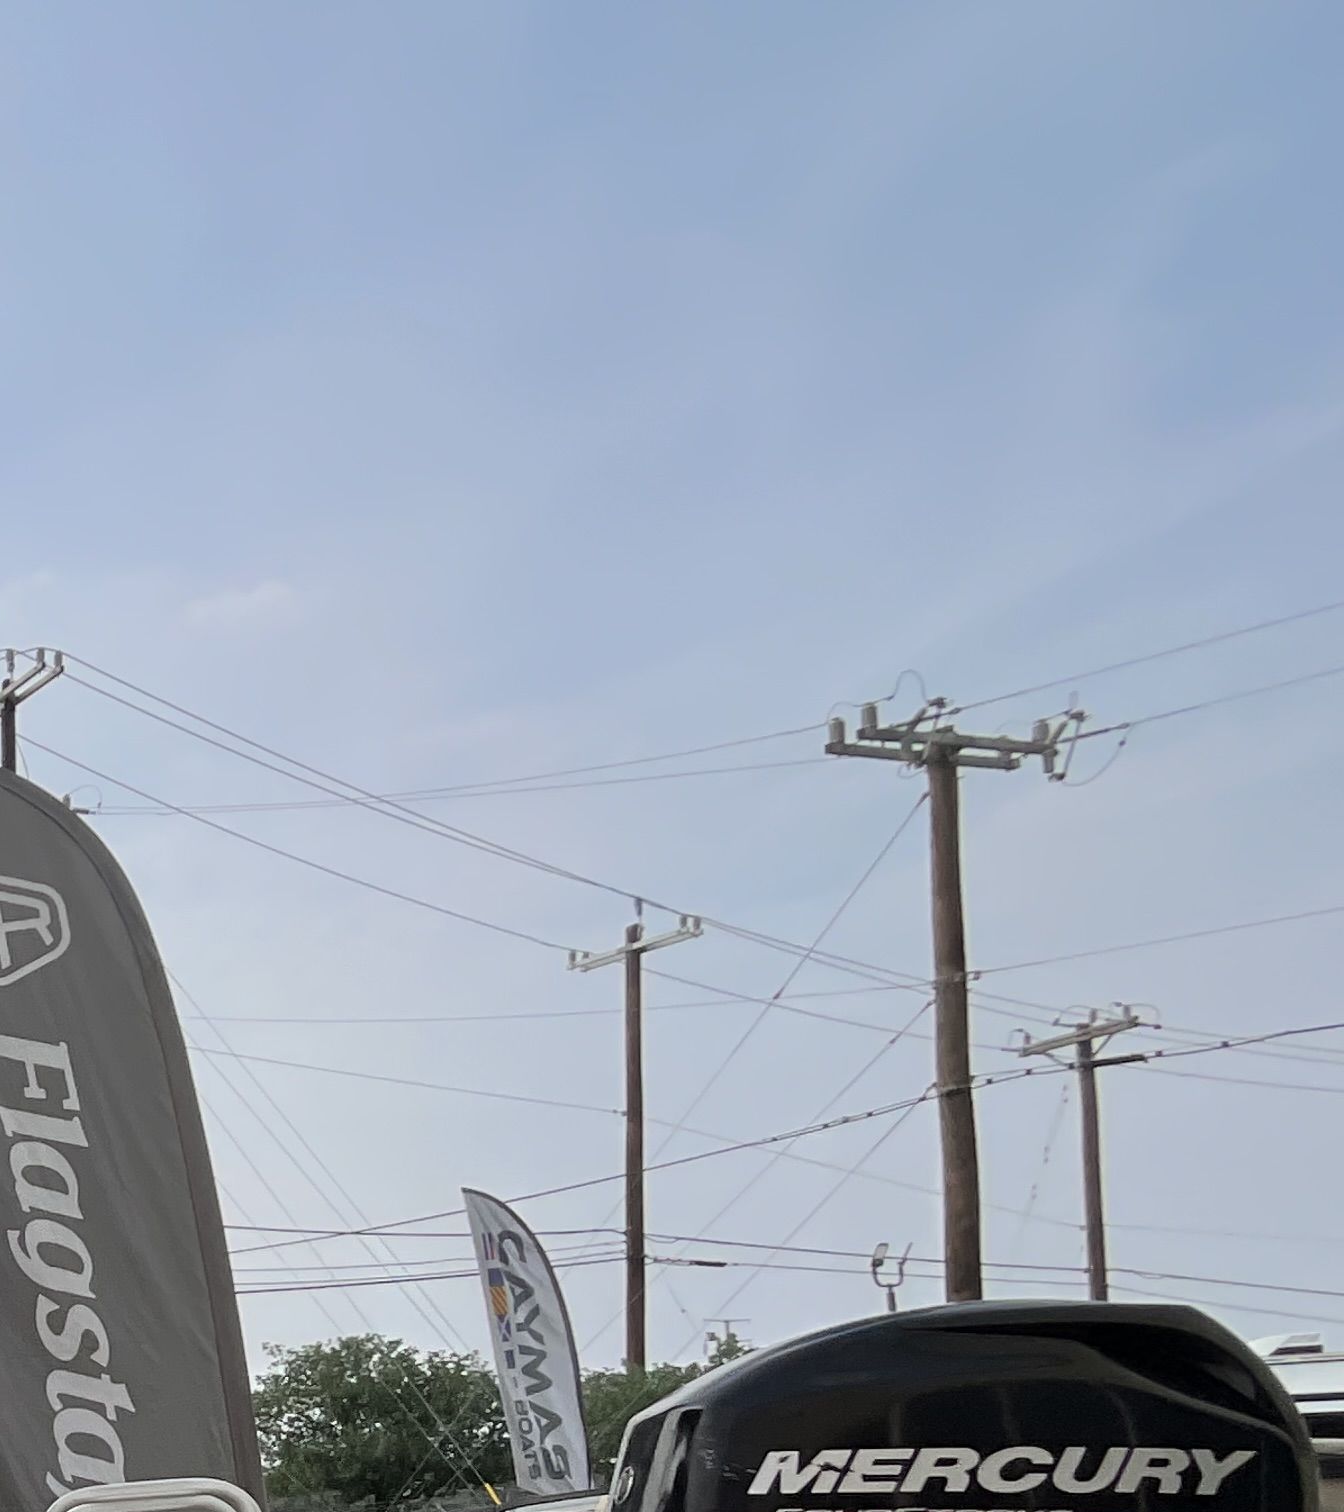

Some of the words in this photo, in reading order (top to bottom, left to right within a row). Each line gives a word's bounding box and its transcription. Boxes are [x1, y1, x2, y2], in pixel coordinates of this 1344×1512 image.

[496, 1229, 573, 1481] CAYMAS
[515, 1399, 542, 1480] BOATS
[747, 1446, 1258, 1496] MERCURY
